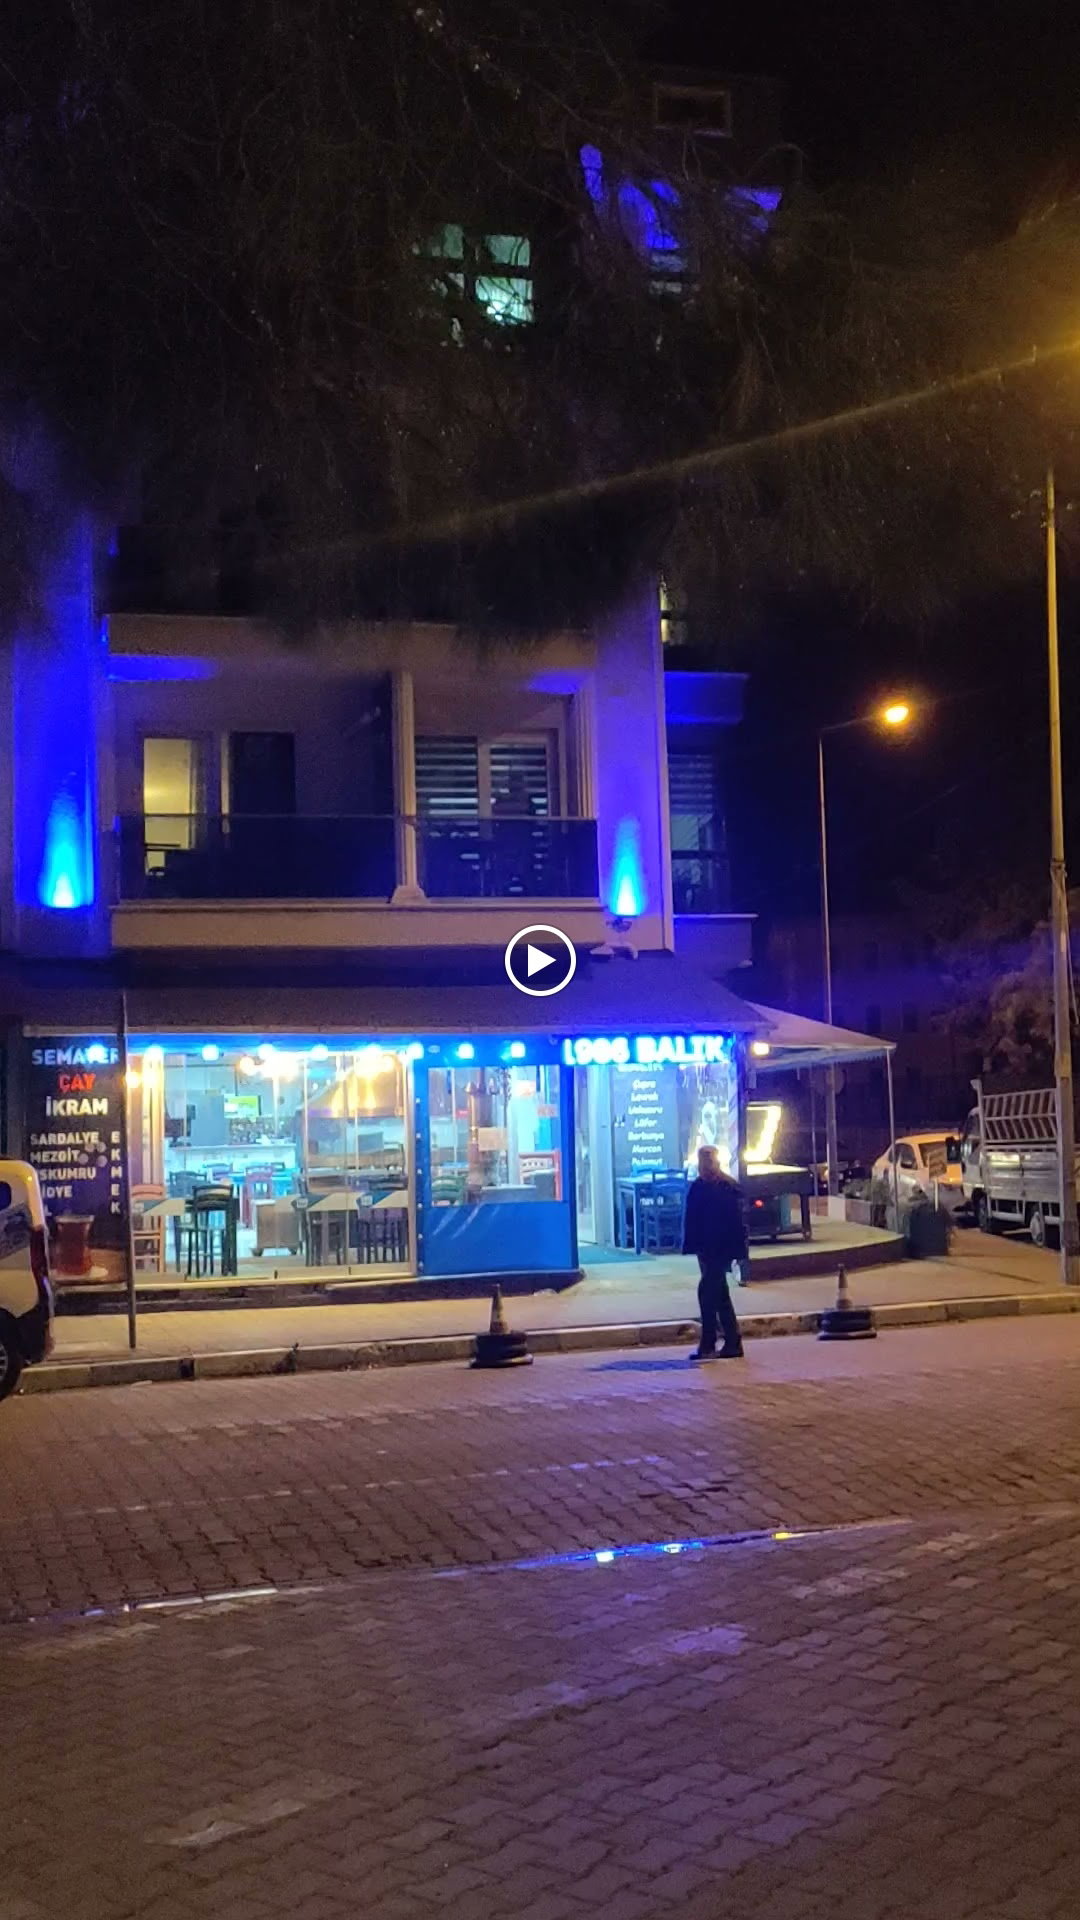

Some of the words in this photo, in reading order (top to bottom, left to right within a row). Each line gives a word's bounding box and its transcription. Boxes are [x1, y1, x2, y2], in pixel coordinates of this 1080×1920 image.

[45, 1095, 108, 1116] İKRAM
[30, 1132, 99, 1145] SARDALYE
[39, 1166, 97, 1180] SKUMRU
[42, 1183, 72, 1198] İDYE
